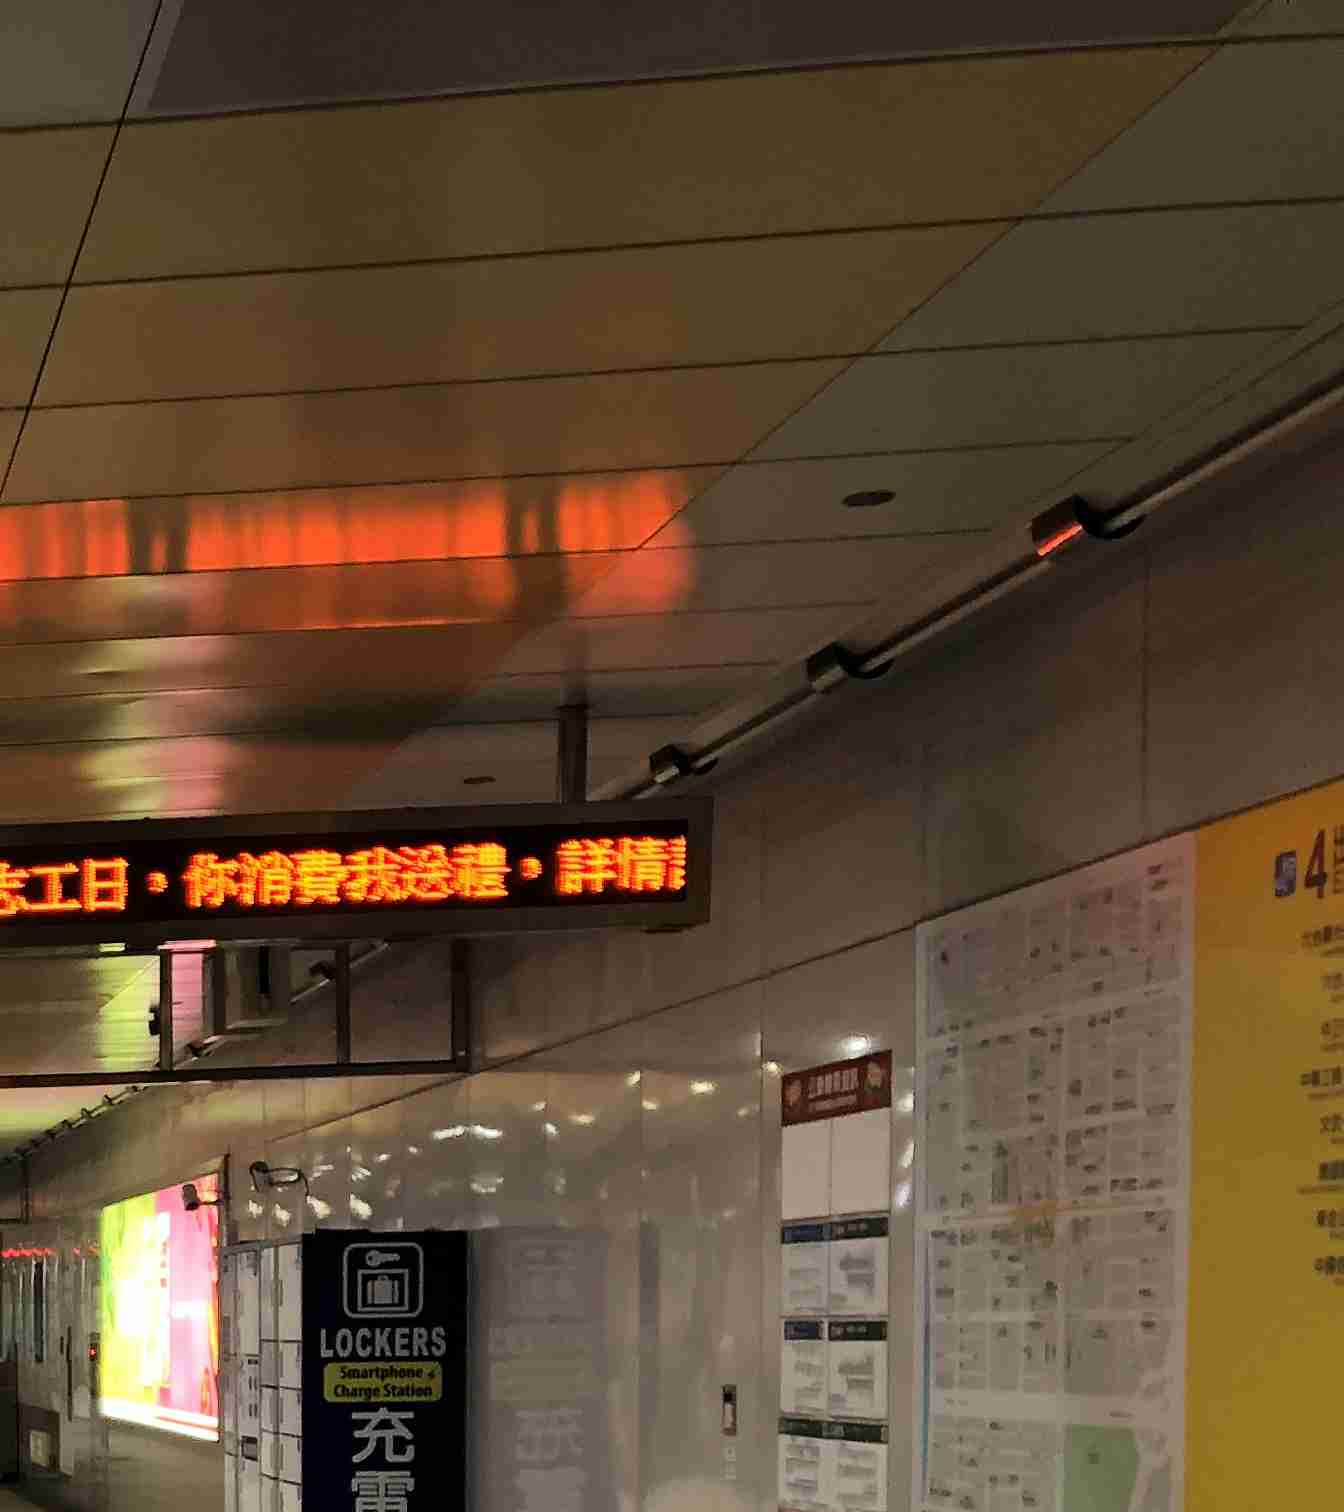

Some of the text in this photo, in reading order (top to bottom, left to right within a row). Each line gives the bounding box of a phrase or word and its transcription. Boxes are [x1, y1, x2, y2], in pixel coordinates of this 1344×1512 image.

[1304, 829, 1328, 899] 4
[319, 1326, 447, 1358] LOCKERS
[339, 1364, 424, 1381] Smartphone
[334, 1383, 433, 1401] Charge Station
